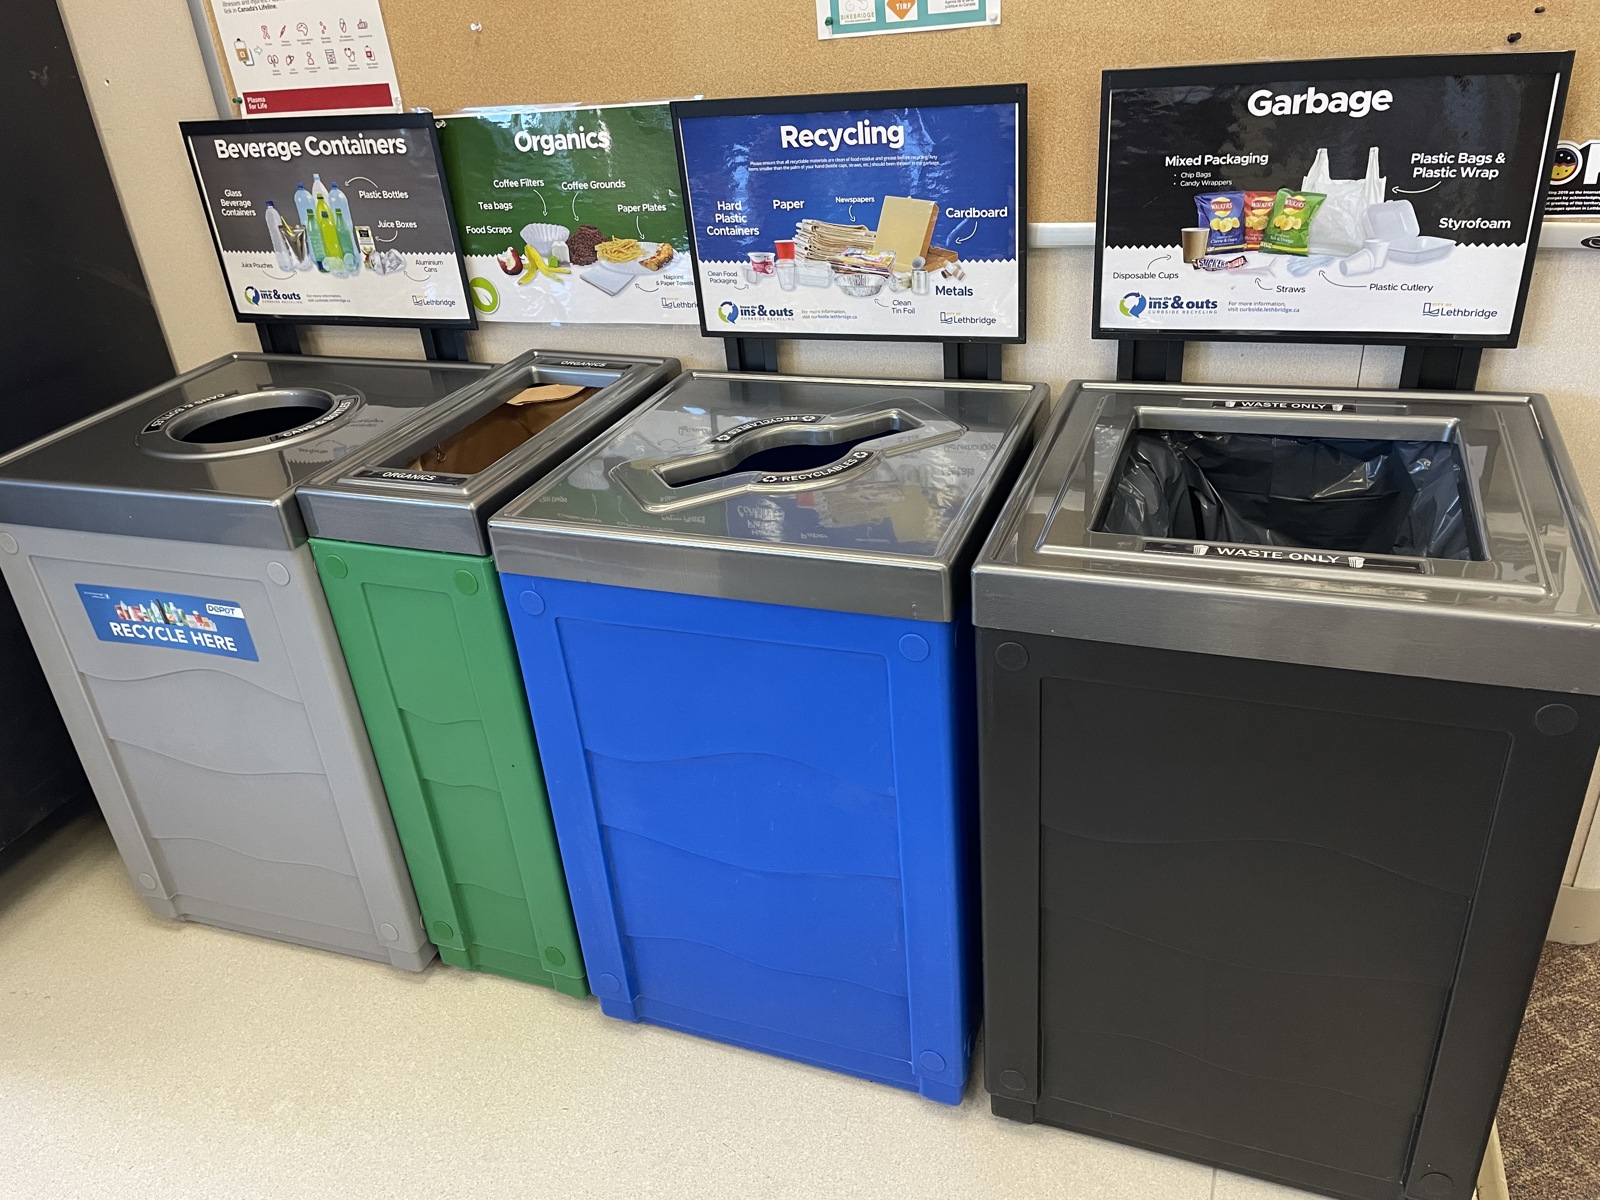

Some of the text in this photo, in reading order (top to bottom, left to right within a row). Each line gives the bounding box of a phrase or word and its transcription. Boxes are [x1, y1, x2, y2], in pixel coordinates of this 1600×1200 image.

[896, 2, 912, 10] TIRF
[840, 12, 875, 20] BIKEBRIDGE
[1247, 86, 1393, 119] Garbage
[514, 126, 610, 155] Organics
[780, 120, 905, 151] Recycling
[214, 132, 407, 161] Beverage Containers
[1165, 152, 1269, 167] Mixed Packaging
[1410, 152, 1506, 167] Plastic Bags &
[1196, 171, 1212, 179] Bags
[1412, 166, 1500, 181] Plastic Wrap
[493, 178, 544, 188] Coffee Filters
[562, 180, 626, 190] Coffee Grounds
[1180, 178, 1232, 188] Candy Wrappers
[224, 189, 242, 198] Glass
[358, 190, 409, 199] Plastic Bottles
[220, 198, 252, 208] Beverage
[717, 200, 742, 211] Hard
[772, 199, 805, 211] Paper
[835, 196, 875, 204] Newspapers
[1211, 201, 1232, 210] WALKERS
[1252, 200, 1274, 208] WALKERS
[221, 208, 257, 216] Containers
[478, 202, 512, 211] Tea bags
[617, 203, 667, 214] Paper Plates
[714, 212, 748, 224] Plastic
[945, 206, 1008, 219] Cardboard
[377, 220, 417, 229] Juice Boxes
[1438, 216, 1511, 231] Styrofoam
[466, 226, 512, 236] Food Scraps
[706, 225, 760, 237] Containers
[1112, 271, 1179, 281] Disposable Cups
[934, 285, 974, 297] Metals
[1276, 284, 1306, 293] Straws
[1369, 283, 1434, 294] Plastic Cutlery
[273, 289, 282, 300] &
[282, 292, 301, 300] outs
[423, 299, 456, 307] Lethbridge
[1148, 296, 1218, 309] ins & outs
[740, 305, 794, 317] ins & outs
[1440, 307, 1498, 320] Lethbridge
[953, 315, 997, 326] Lethbridge
[560, 360, 606, 368] ORGANICS
[1241, 401, 1288, 409] WASTE
[283, 428, 310, 438] CANS
[326, 401, 352, 422] BOTTLES
[728, 416, 799, 436] RECYCLABLES
[782, 458, 858, 482] RECYCLABLES
[382, 471, 436, 481] ORGANICS
[1216, 547, 1340, 564] WASTE ONLY
[208, 604, 236, 615] DEPOT
[110, 621, 238, 652] RECYCLE HERE
